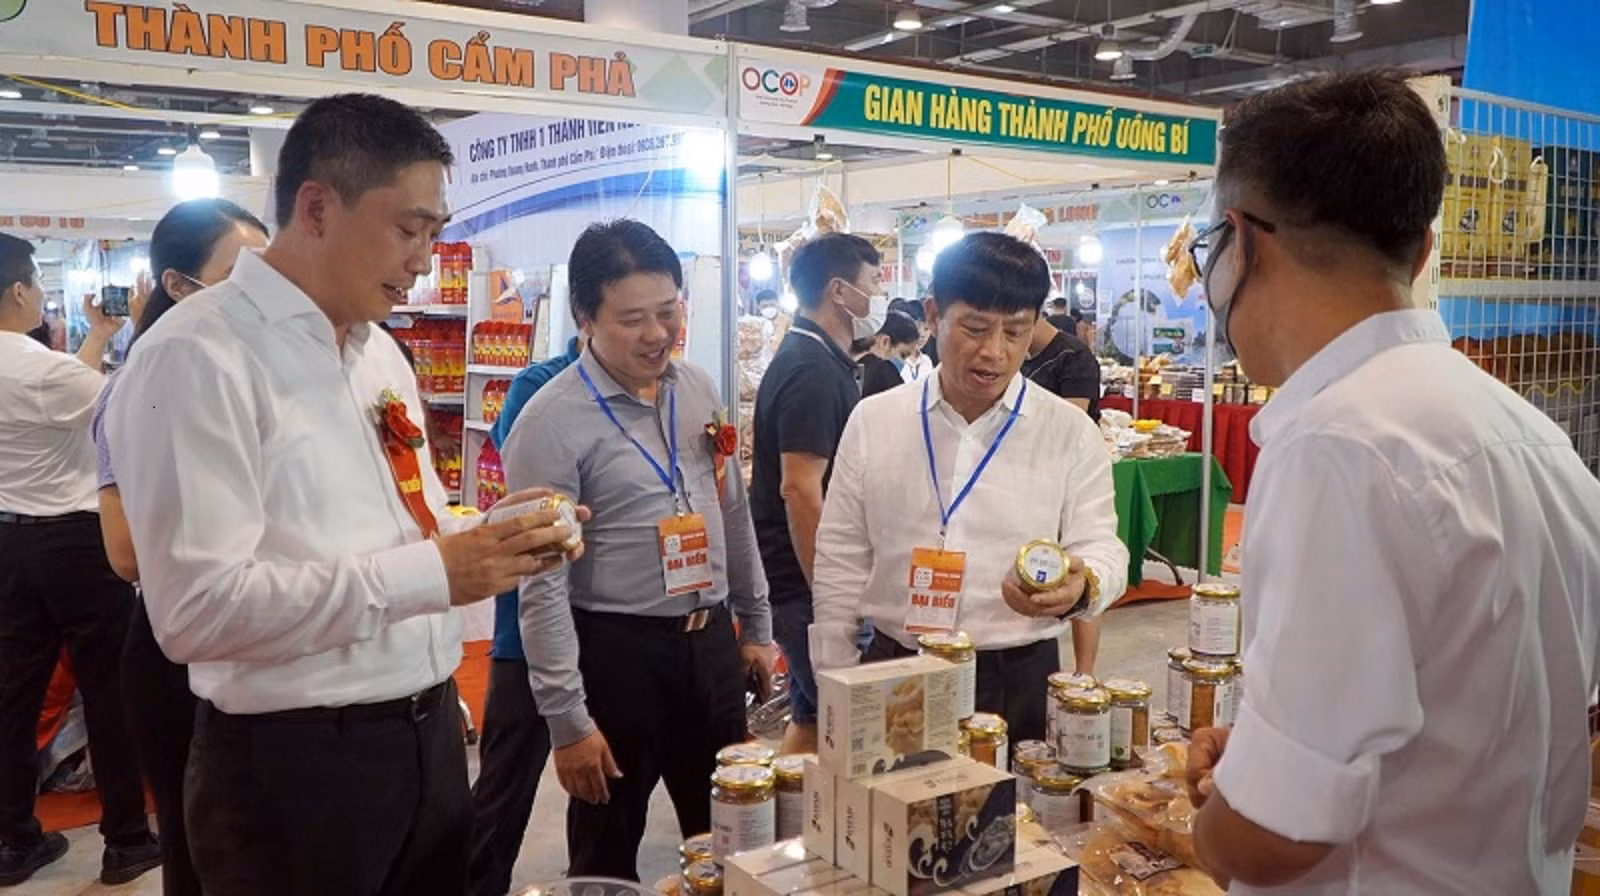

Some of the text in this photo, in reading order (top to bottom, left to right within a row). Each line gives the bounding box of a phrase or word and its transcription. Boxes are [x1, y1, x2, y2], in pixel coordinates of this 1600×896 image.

[85, 0, 637, 98] THÀNH PHỐ CẨM PHẢ
[742, 66, 812, 96] OCOP
[469, 137, 495, 163] CÔNG
[496, 134, 508, 156] TY
[509, 127, 537, 154] TNHH
[539, 125, 545, 147] 1
[863, 84, 1190, 155] GIAN HÀNG THÀNH PHỐ UÔNG BÍ
